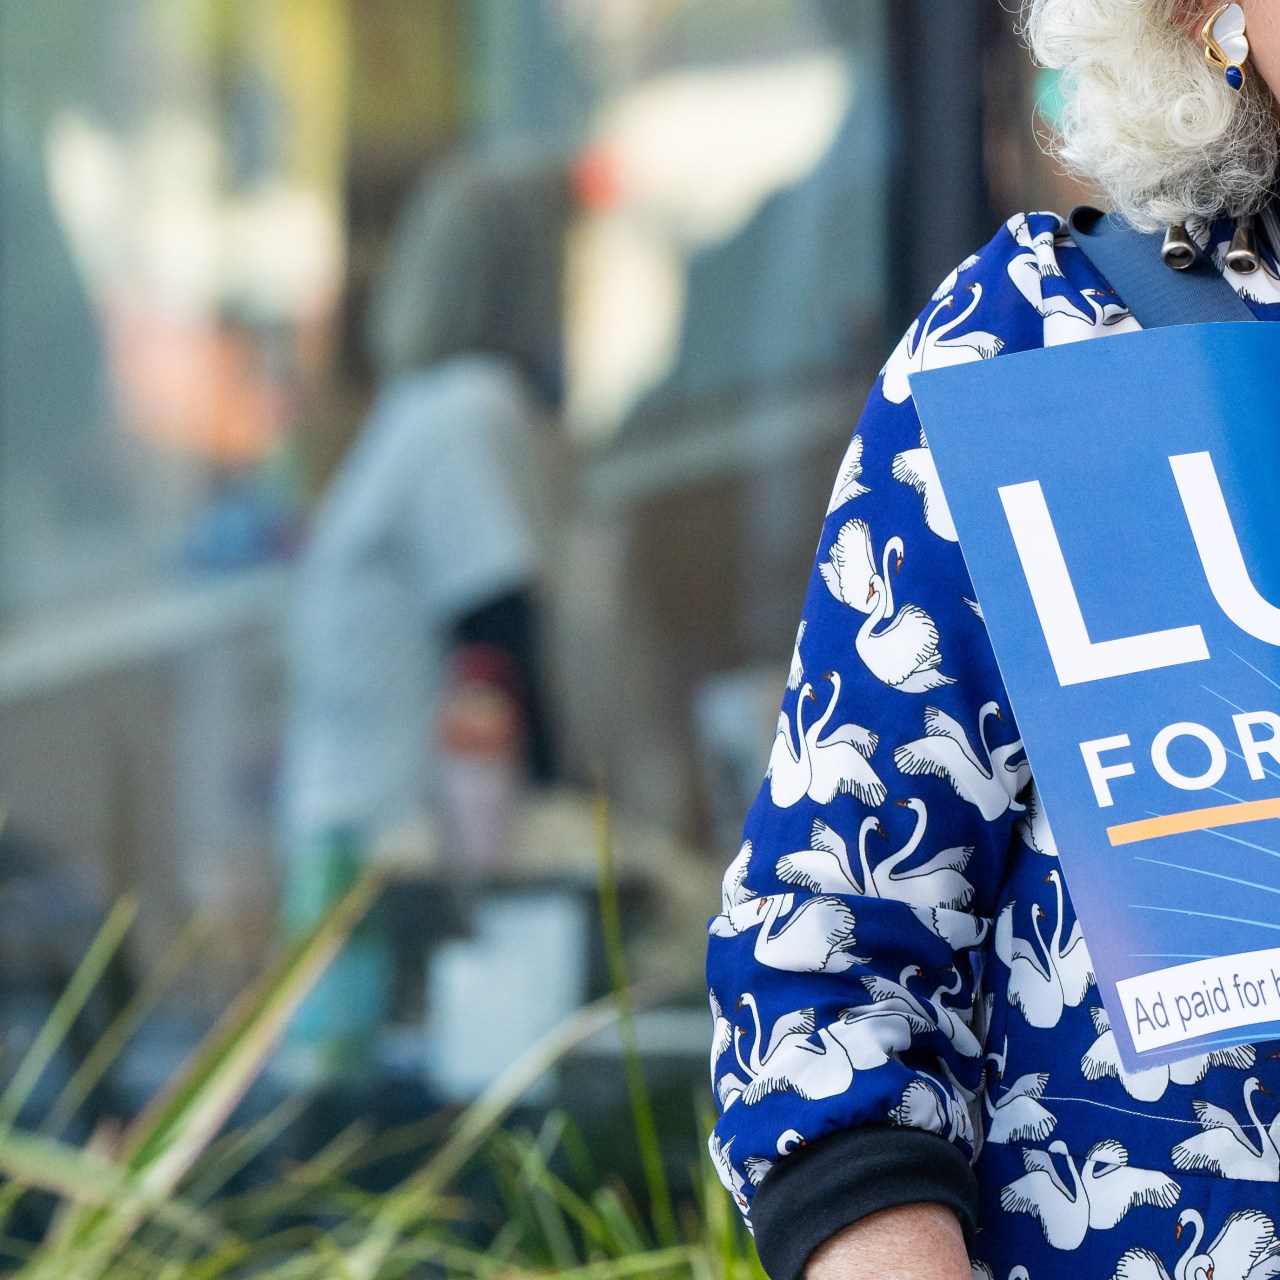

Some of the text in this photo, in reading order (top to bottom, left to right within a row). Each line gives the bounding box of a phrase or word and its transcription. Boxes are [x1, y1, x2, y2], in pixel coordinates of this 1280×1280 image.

[1134, 991, 1168, 1035] Ad
[1175, 977, 1230, 1032] paid
[1233, 973, 1267, 1009] for
